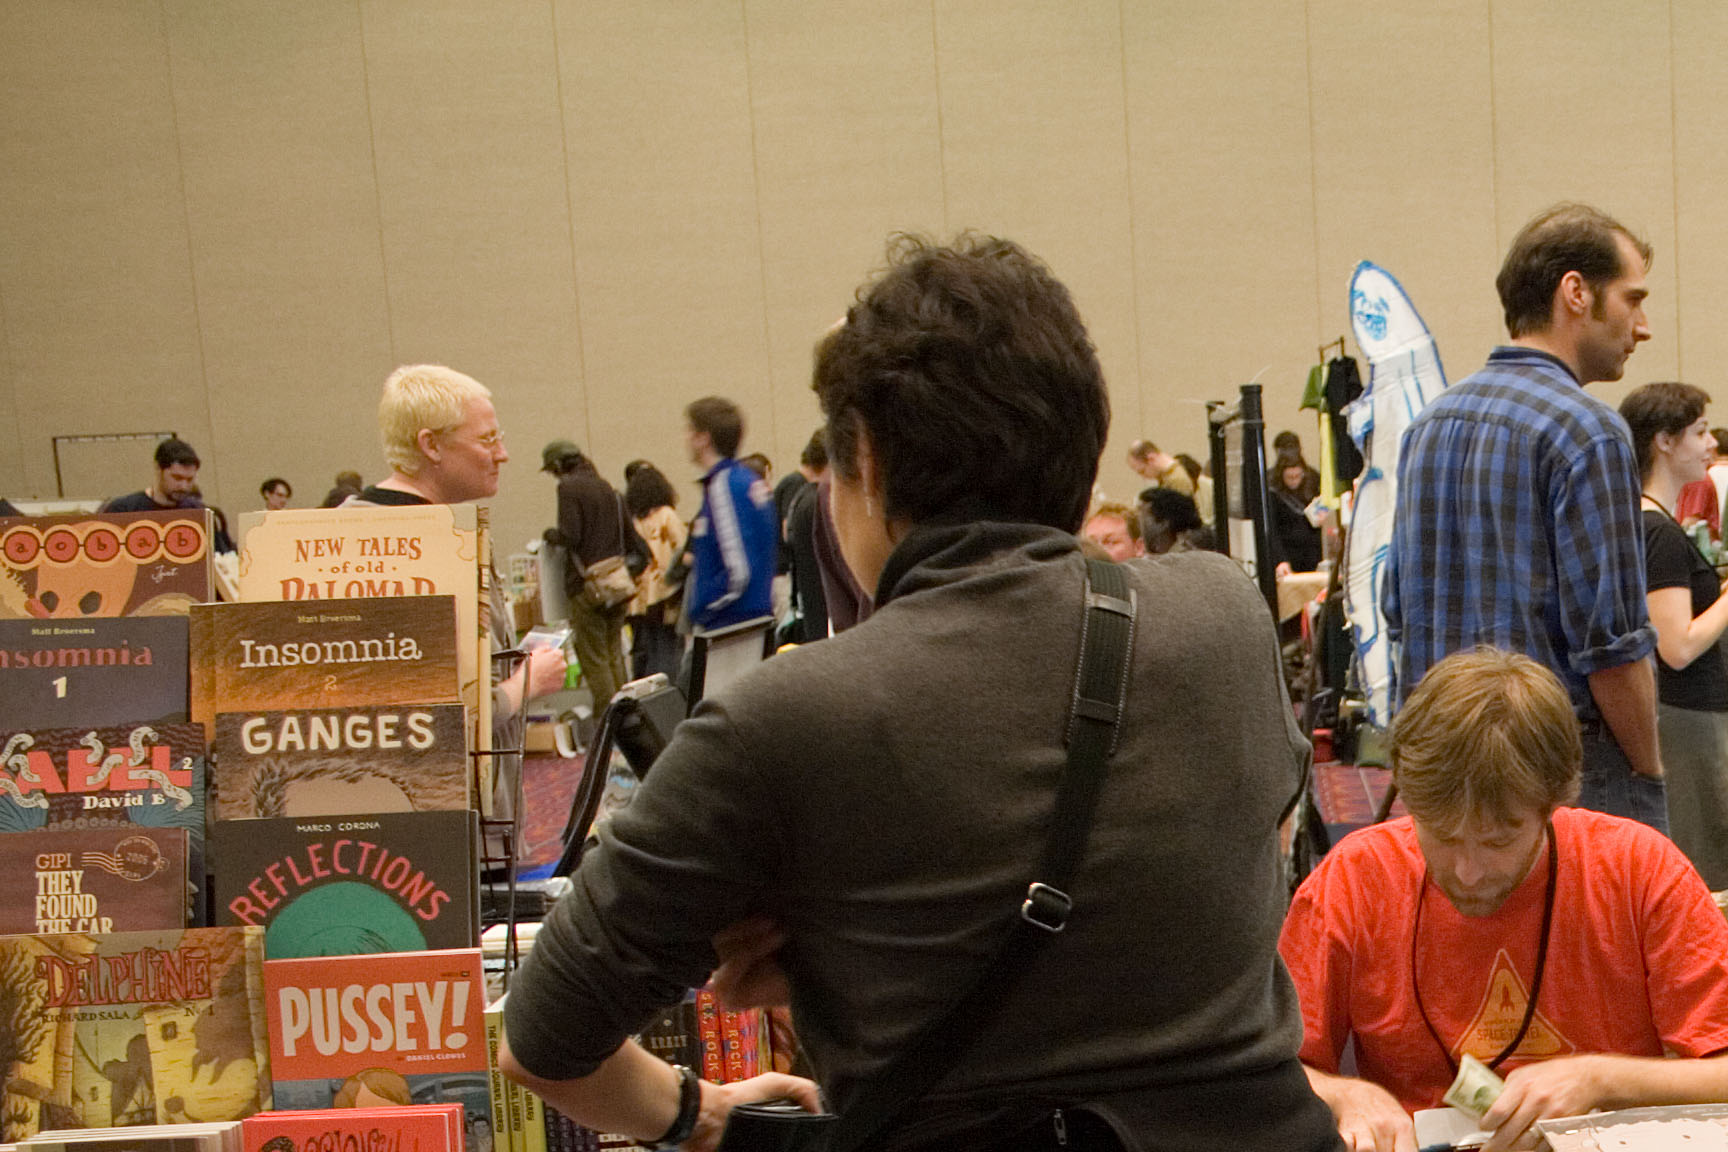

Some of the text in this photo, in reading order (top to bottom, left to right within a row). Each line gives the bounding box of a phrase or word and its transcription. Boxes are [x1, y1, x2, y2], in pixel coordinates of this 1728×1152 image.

[295, 536, 422, 563] NEW TALES
[331, 561, 385, 574] of old
[0, 639, 153, 669] somnia
[240, 632, 422, 668] Insomnia
[52, 677, 67, 698] 1
[324, 675, 337, 691] 2
[240, 712, 435, 755] GANGES
[182, 757, 193, 769] 2
[83, 792, 143, 810] David
[297, 821, 331, 833] MARCO
[36, 853, 72, 869] GIPI
[36, 870, 84, 895] THEY
[228, 839, 451, 926] REFLECTIONS
[36, 894, 97, 918] FOUND
[36, 917, 113, 935] THE CAR
[35, 947, 213, 1008] DELPHINE
[99, 1010, 130, 1021] SALA
[278, 981, 471, 1057] PUSSEY!
[705, 1031, 720, 1072] ROCK
[728, 1030, 743, 1070] ROCK
